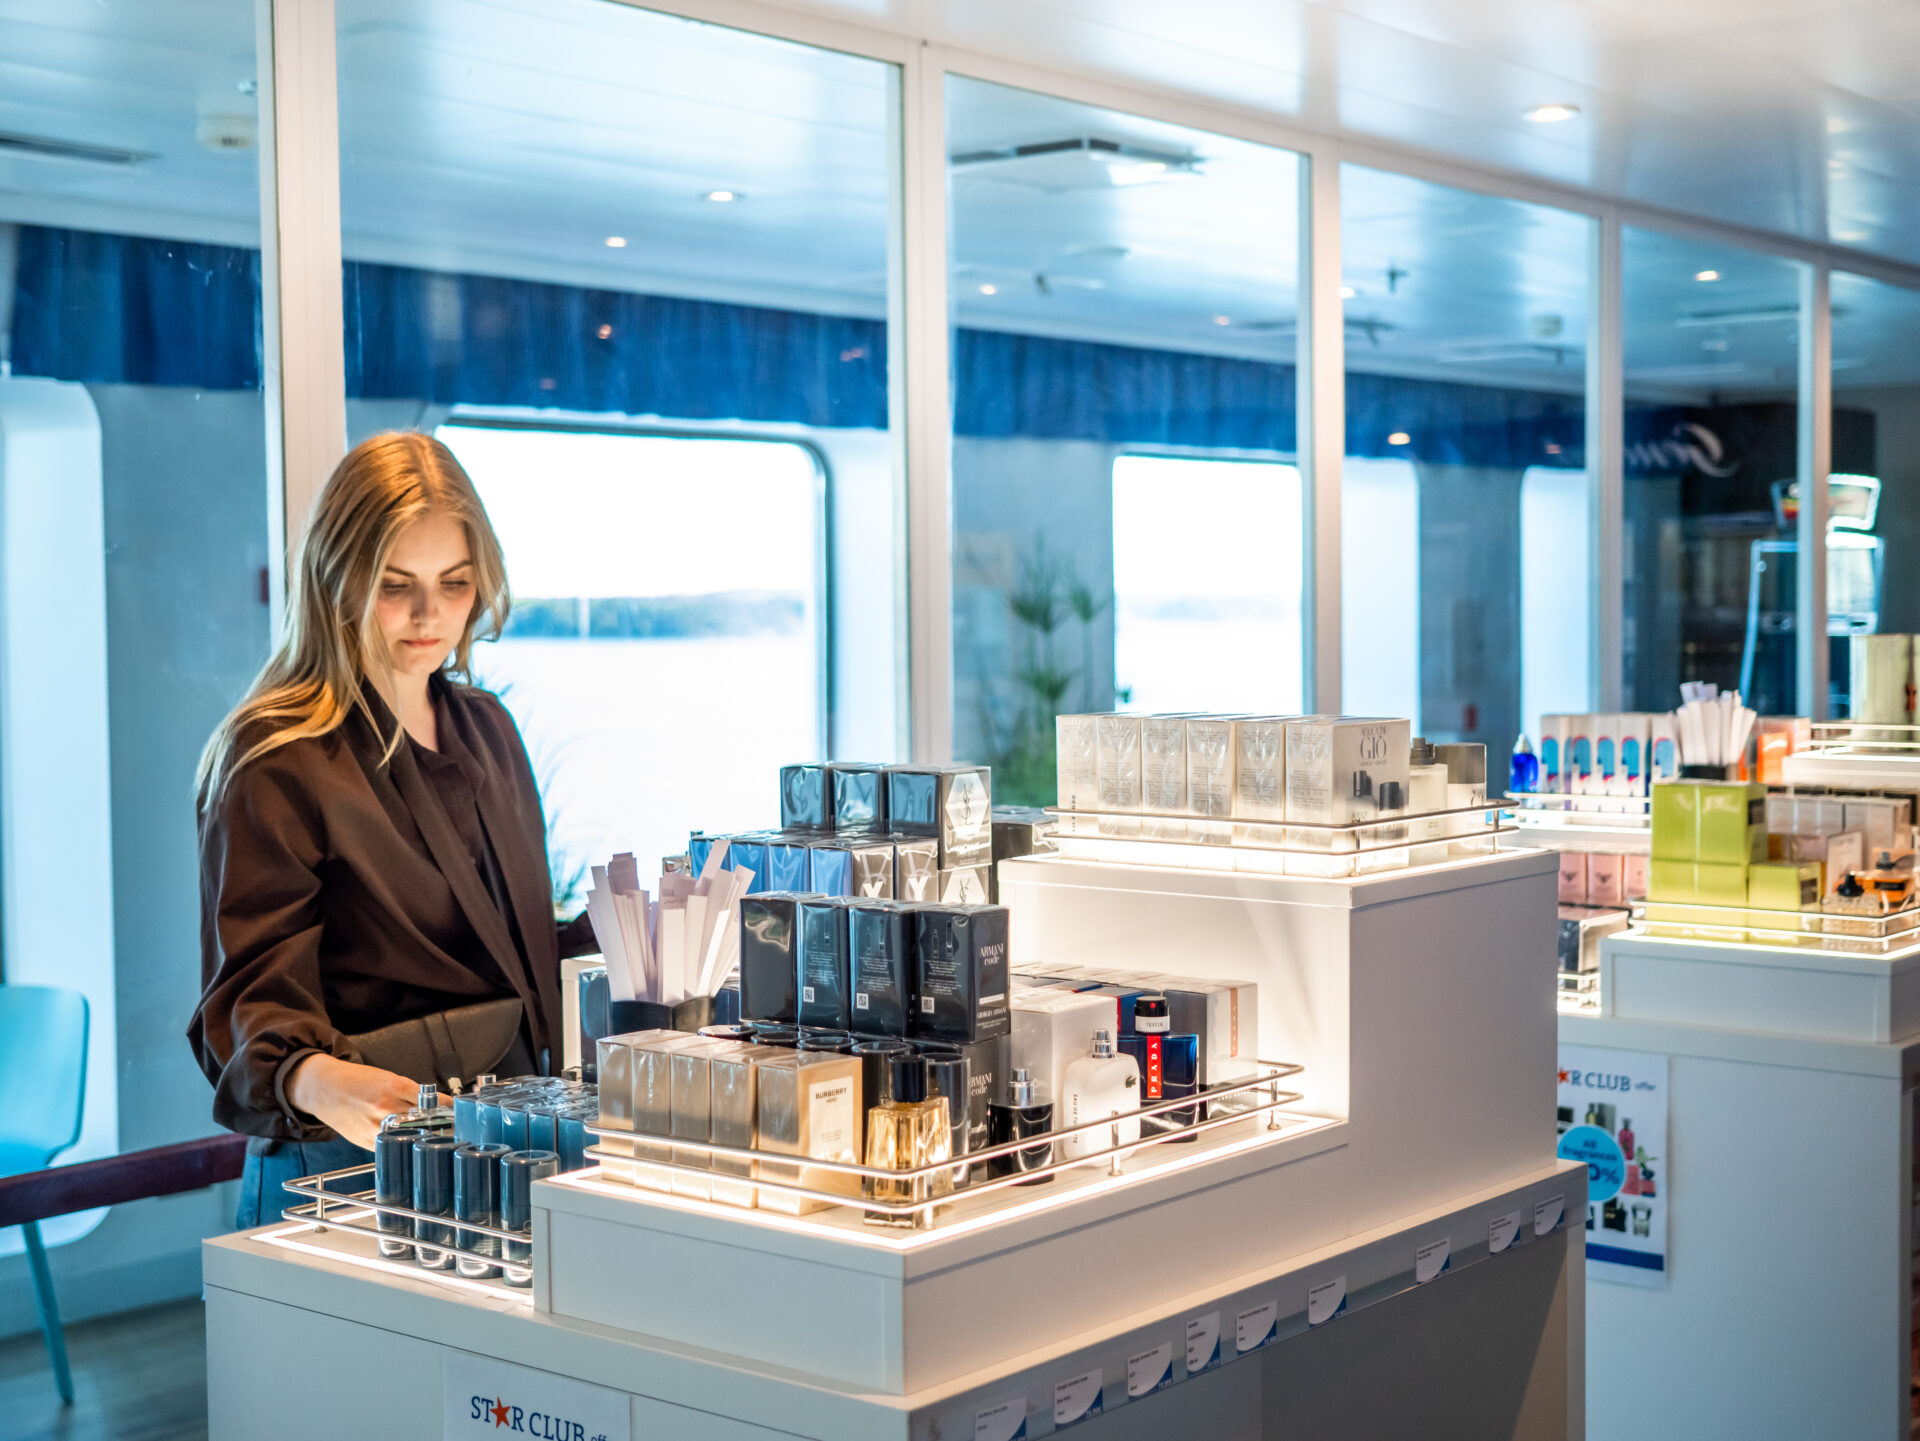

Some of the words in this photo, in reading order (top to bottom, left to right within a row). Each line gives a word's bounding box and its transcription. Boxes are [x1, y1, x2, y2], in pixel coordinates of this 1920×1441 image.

[980, 943, 1005, 959] ARMANI
[984, 955, 1001, 967] code
[1150, 1042, 1159, 1093] PRADA
[970, 1071, 993, 1087] RMANI
[1585, 1073, 1631, 1091] CLUB
[815, 1087, 848, 1100] BURBERRY
[971, 1082, 989, 1096] code
[529, 1412, 585, 1441] CLUB
